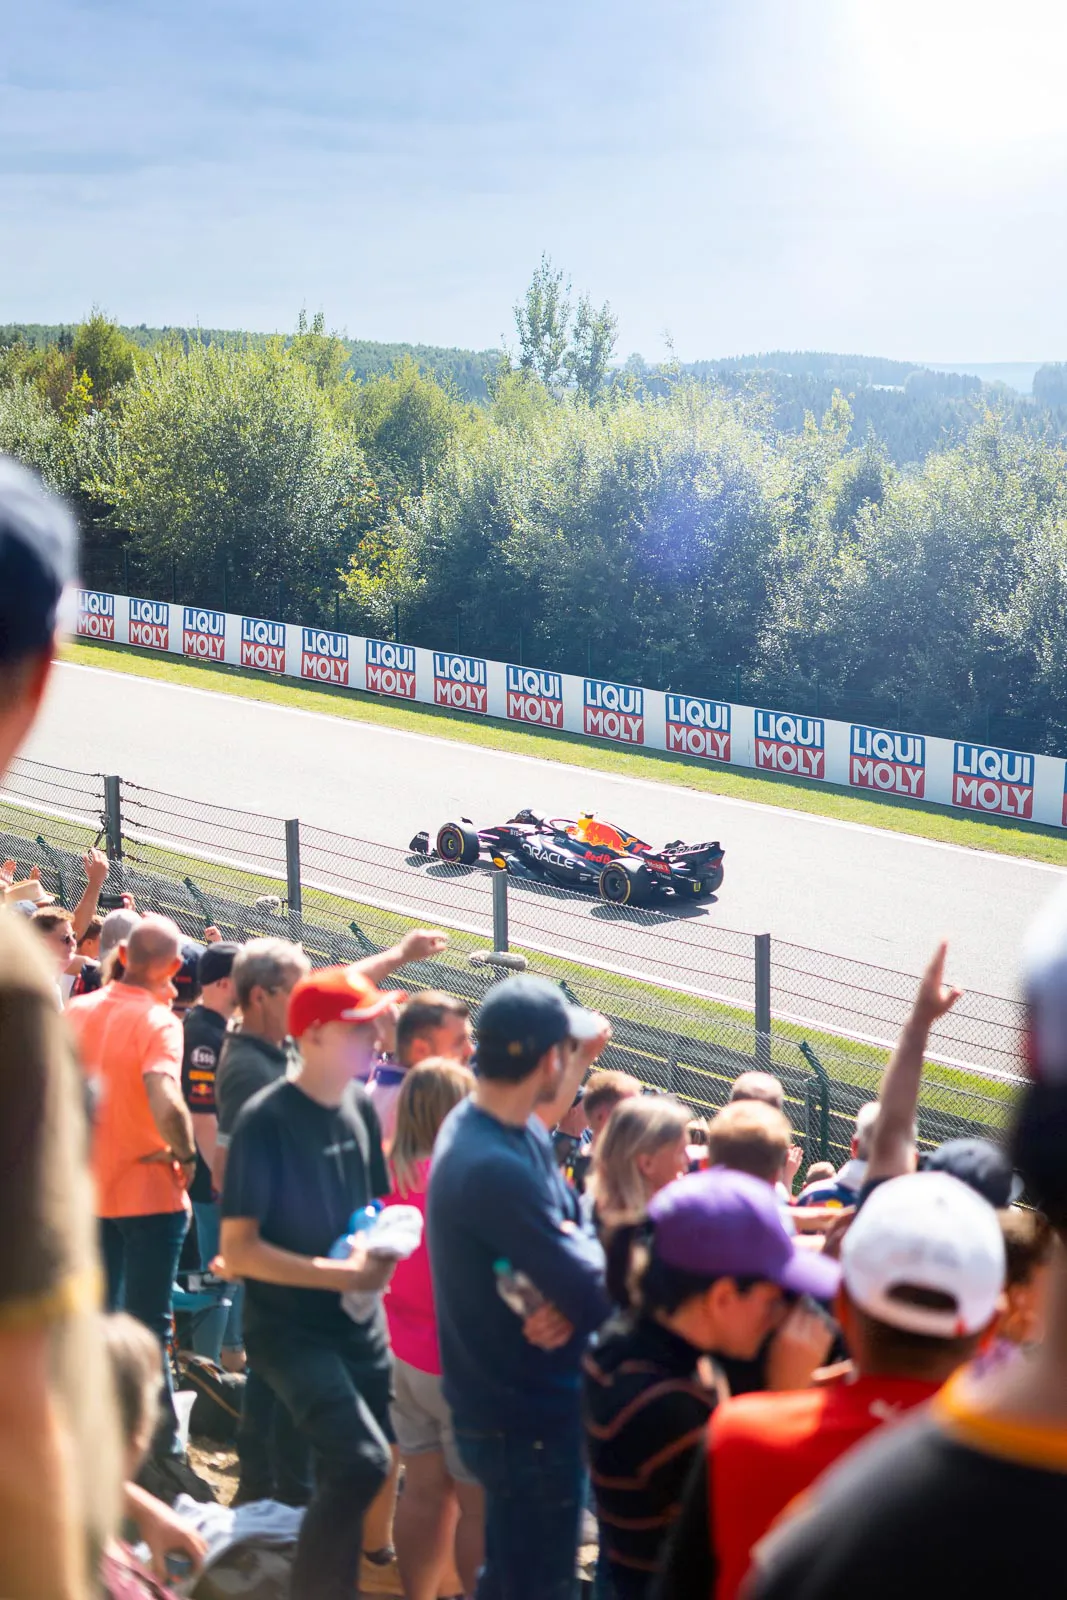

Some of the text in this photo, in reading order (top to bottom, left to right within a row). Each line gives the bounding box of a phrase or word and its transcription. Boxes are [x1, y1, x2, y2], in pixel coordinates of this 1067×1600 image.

[79, 592, 113, 616] LIQUI
[130, 600, 168, 626] LIQUI
[78, 614, 114, 638] MOLY
[185, 609, 224, 635] LIQUI
[243, 620, 284, 646] LIQUI
[130, 625, 168, 648] MOLY
[185, 634, 225, 658] MOLY
[304, 630, 346, 658] LIQUI
[242, 644, 285, 670] MOLY
[304, 657, 347, 682] MOLY
[368, 641, 414, 671] LIQUI
[436, 654, 484, 684] LIQUI
[368, 669, 414, 696] MOLY
[437, 682, 486, 710] MOLY
[509, 668, 559, 699] LIQUI
[509, 695, 562, 724] MOLY
[587, 682, 641, 714] LIQUI
[586, 710, 642, 741] MOLY
[669, 697, 728, 730] LIQUI
[669, 726, 729, 758] MOLY
[758, 712, 821, 747] LIQUI
[758, 741, 823, 775] MOLY
[854, 728, 922, 764] LIQUI
[853, 760, 923, 794] MOLY
[958, 746, 1030, 784] LIQUI
[957, 777, 1031, 814] MOLY
[522, 843, 575, 869] ORACLE
[584, 851, 603, 863] Red
